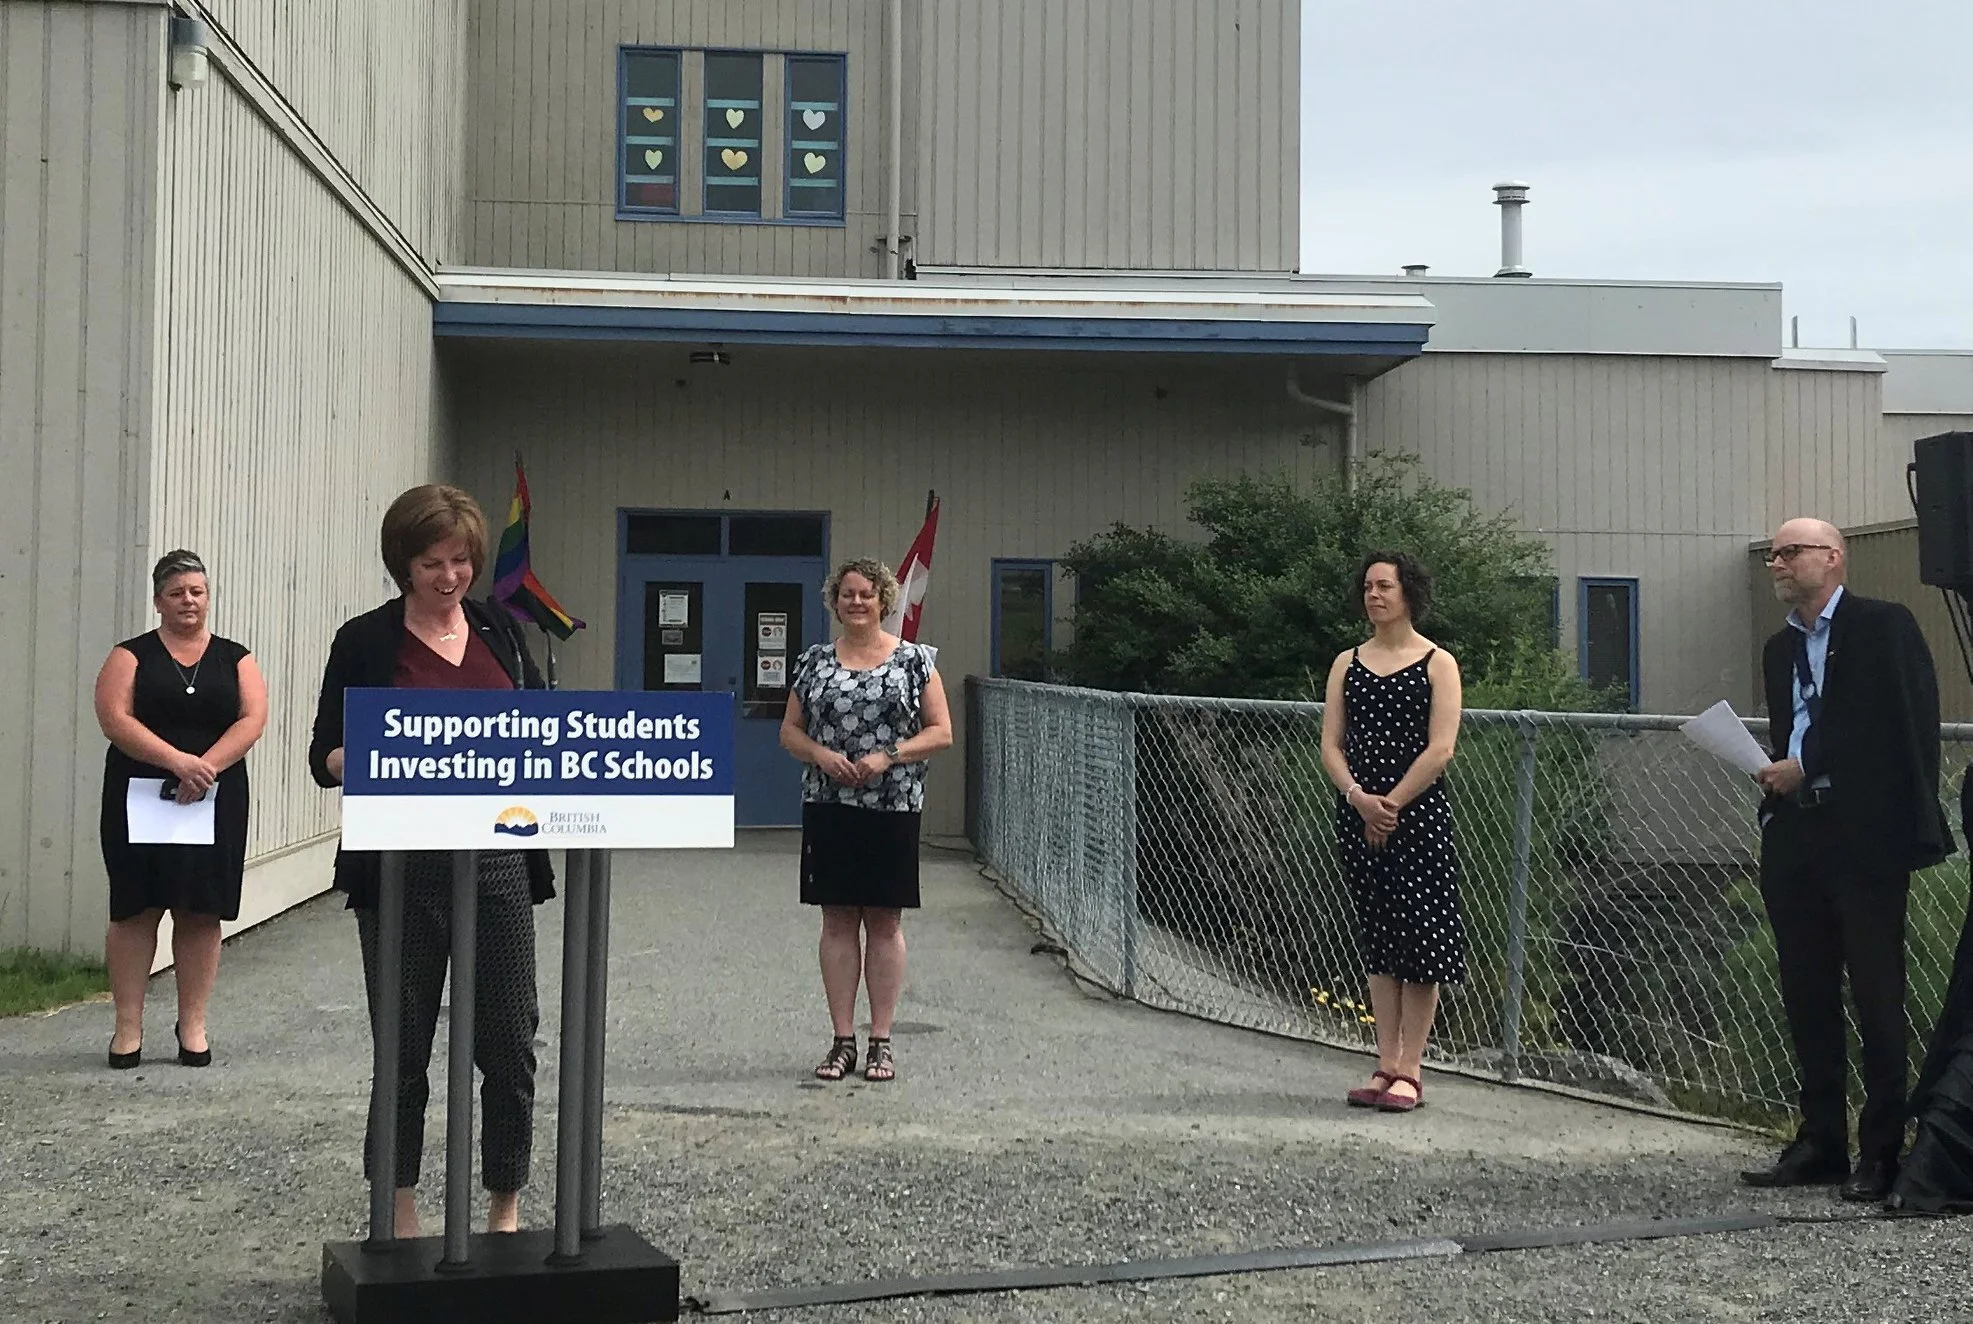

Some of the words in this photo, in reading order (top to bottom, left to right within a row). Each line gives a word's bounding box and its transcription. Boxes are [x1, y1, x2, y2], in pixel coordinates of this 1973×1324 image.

[384, 708, 559, 746] Supporting
[566, 710, 700, 741] Students
[369, 749, 516, 787] Investing
[523, 749, 552, 780] in
[560, 750, 599, 780] BC
[604, 751, 714, 781] Schools
[541, 822, 608, 835] COLUMBIA
[549, 811, 601, 823] BRITISH
